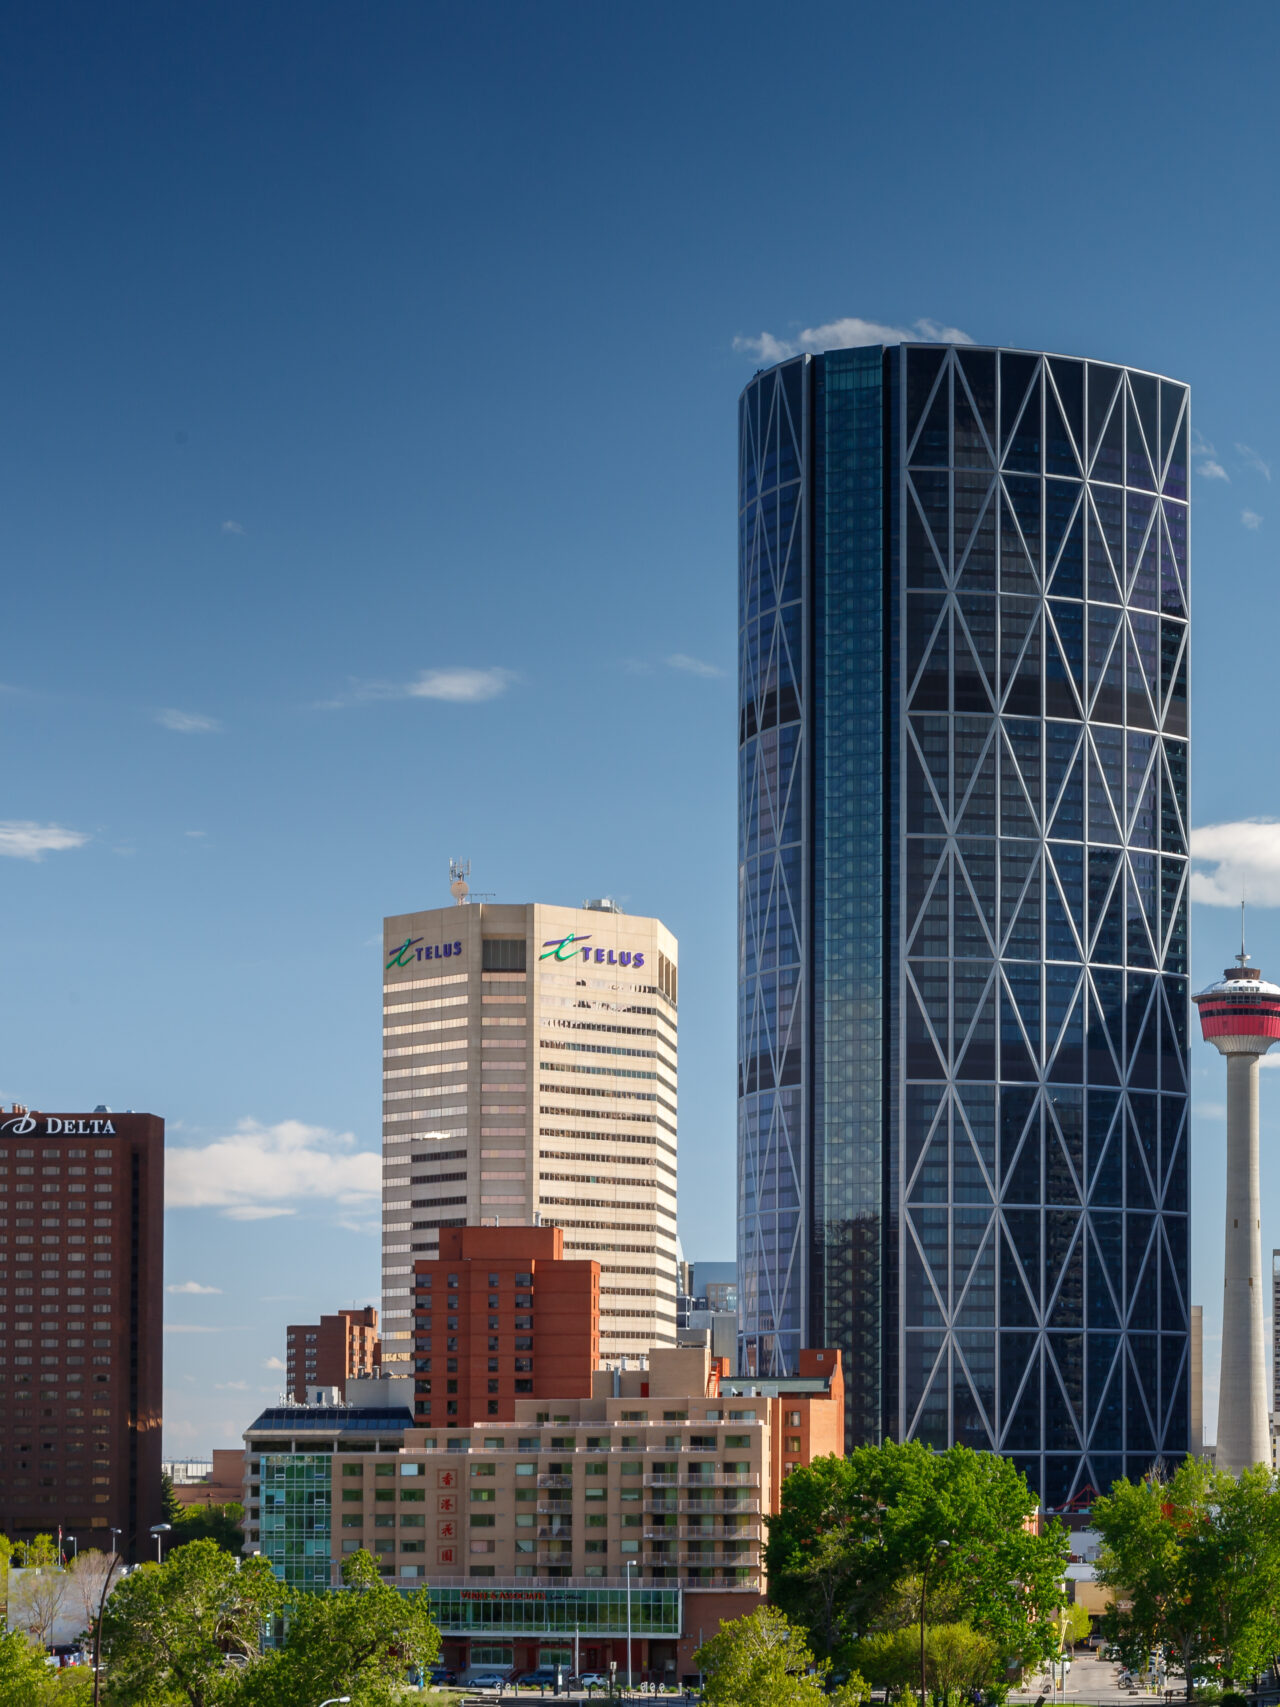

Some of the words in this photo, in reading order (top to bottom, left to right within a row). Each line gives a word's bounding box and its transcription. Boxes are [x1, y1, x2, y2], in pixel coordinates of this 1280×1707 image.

[415, 941, 462, 961] TELUS
[580, 946, 645, 969] TELUS
[46, 1117, 115, 1134] DELTA
